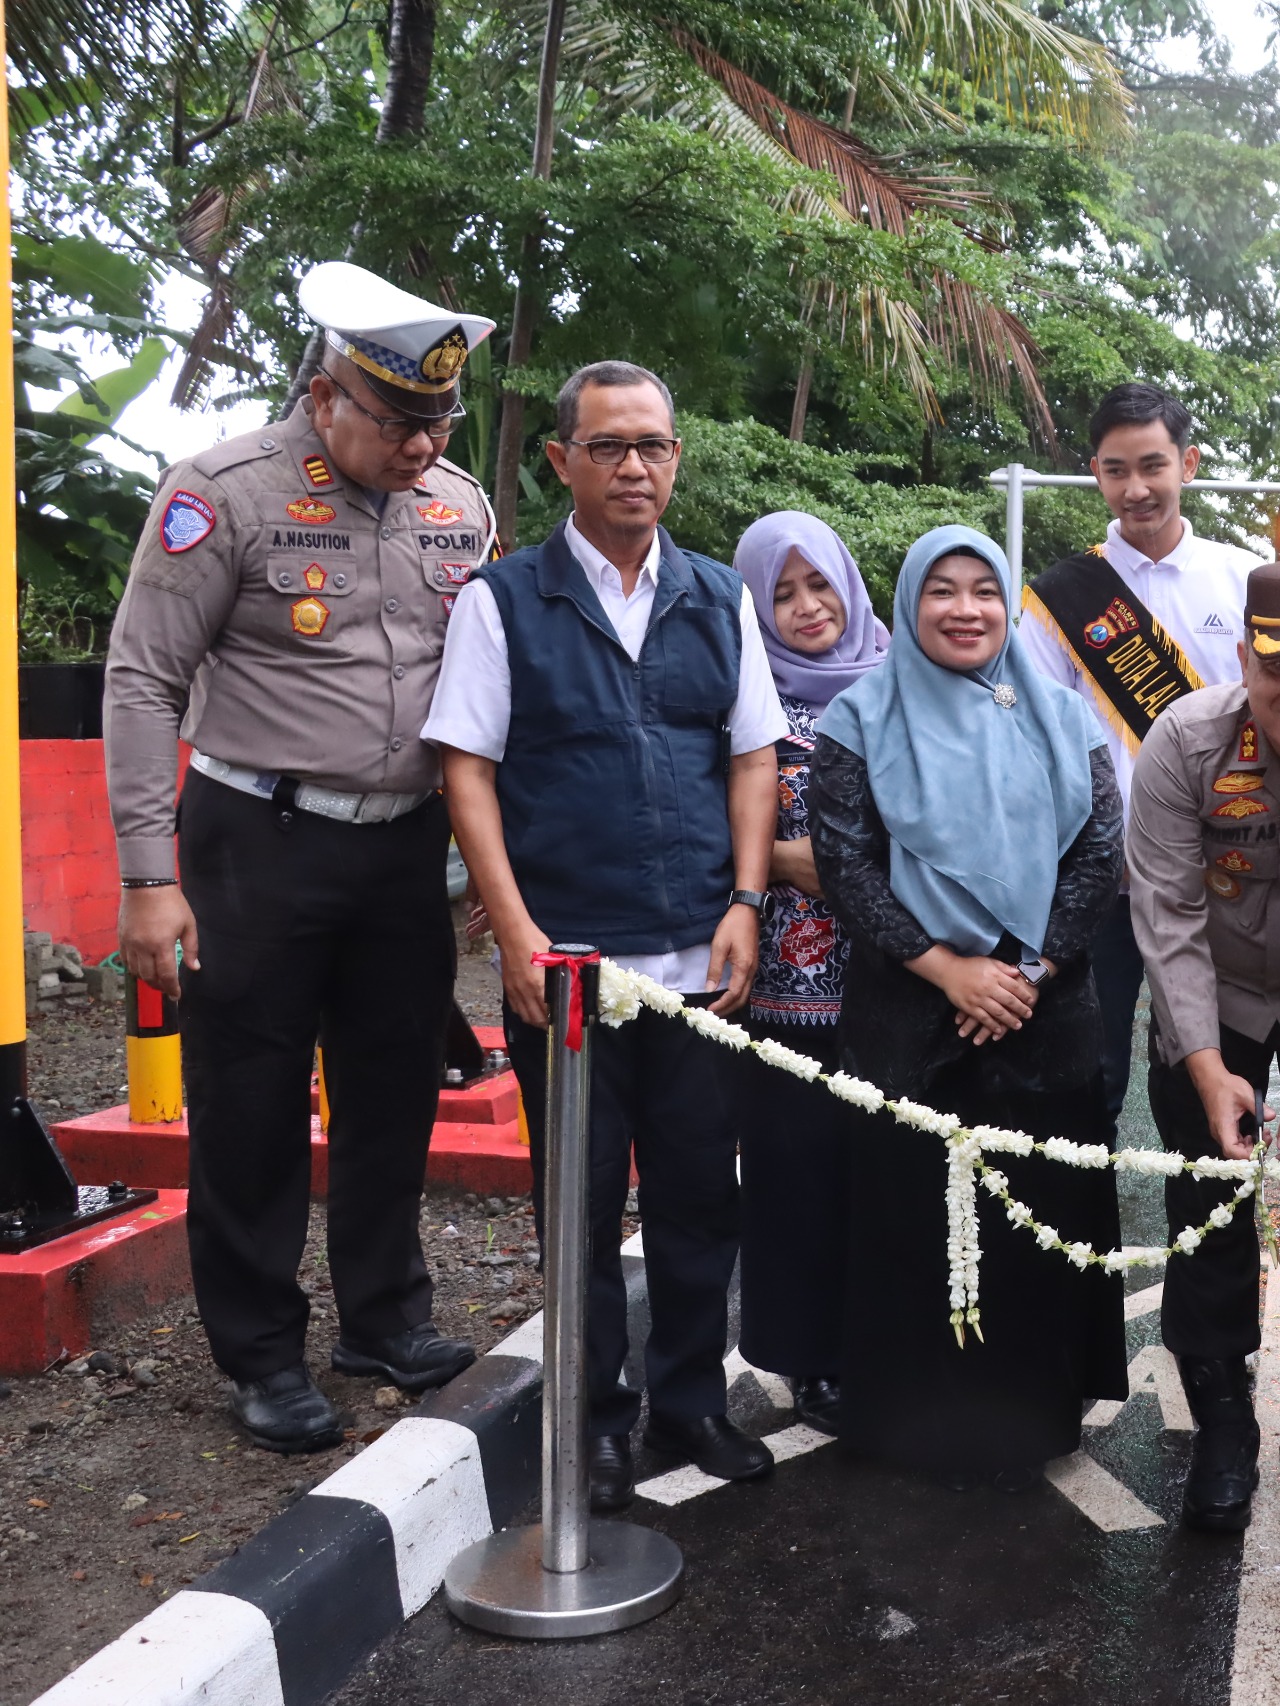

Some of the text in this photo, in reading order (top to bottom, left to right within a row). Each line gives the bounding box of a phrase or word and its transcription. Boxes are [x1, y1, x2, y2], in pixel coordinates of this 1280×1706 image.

[177, 493, 213, 519] LALU LINTAS
[272, 530, 351, 551] A.NASUTION
[418, 532, 476, 550] POLRI
[1114, 600, 1138, 627] POLRES
[1106, 634, 1181, 720] DUTA LAL
